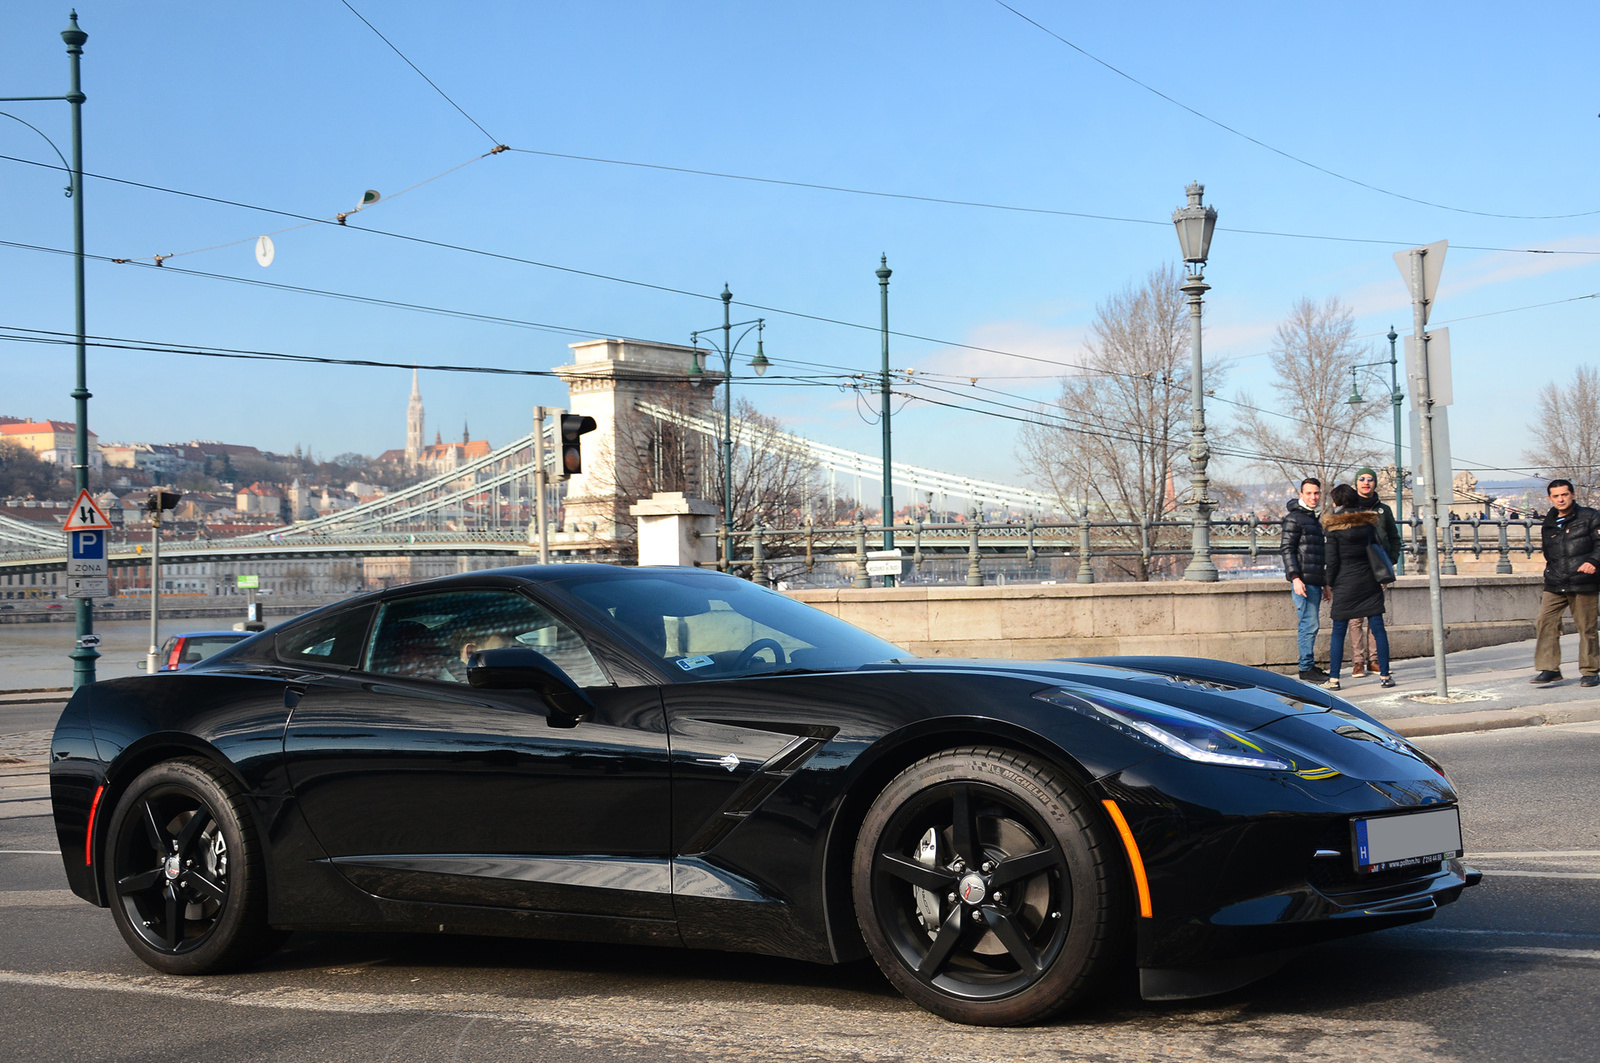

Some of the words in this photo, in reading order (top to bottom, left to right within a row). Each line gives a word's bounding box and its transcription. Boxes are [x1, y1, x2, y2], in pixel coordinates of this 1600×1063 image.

[79, 532, 97, 554] P
[1002, 770, 1050, 803] MICHELIN
[1360, 846, 1367, 859] H
